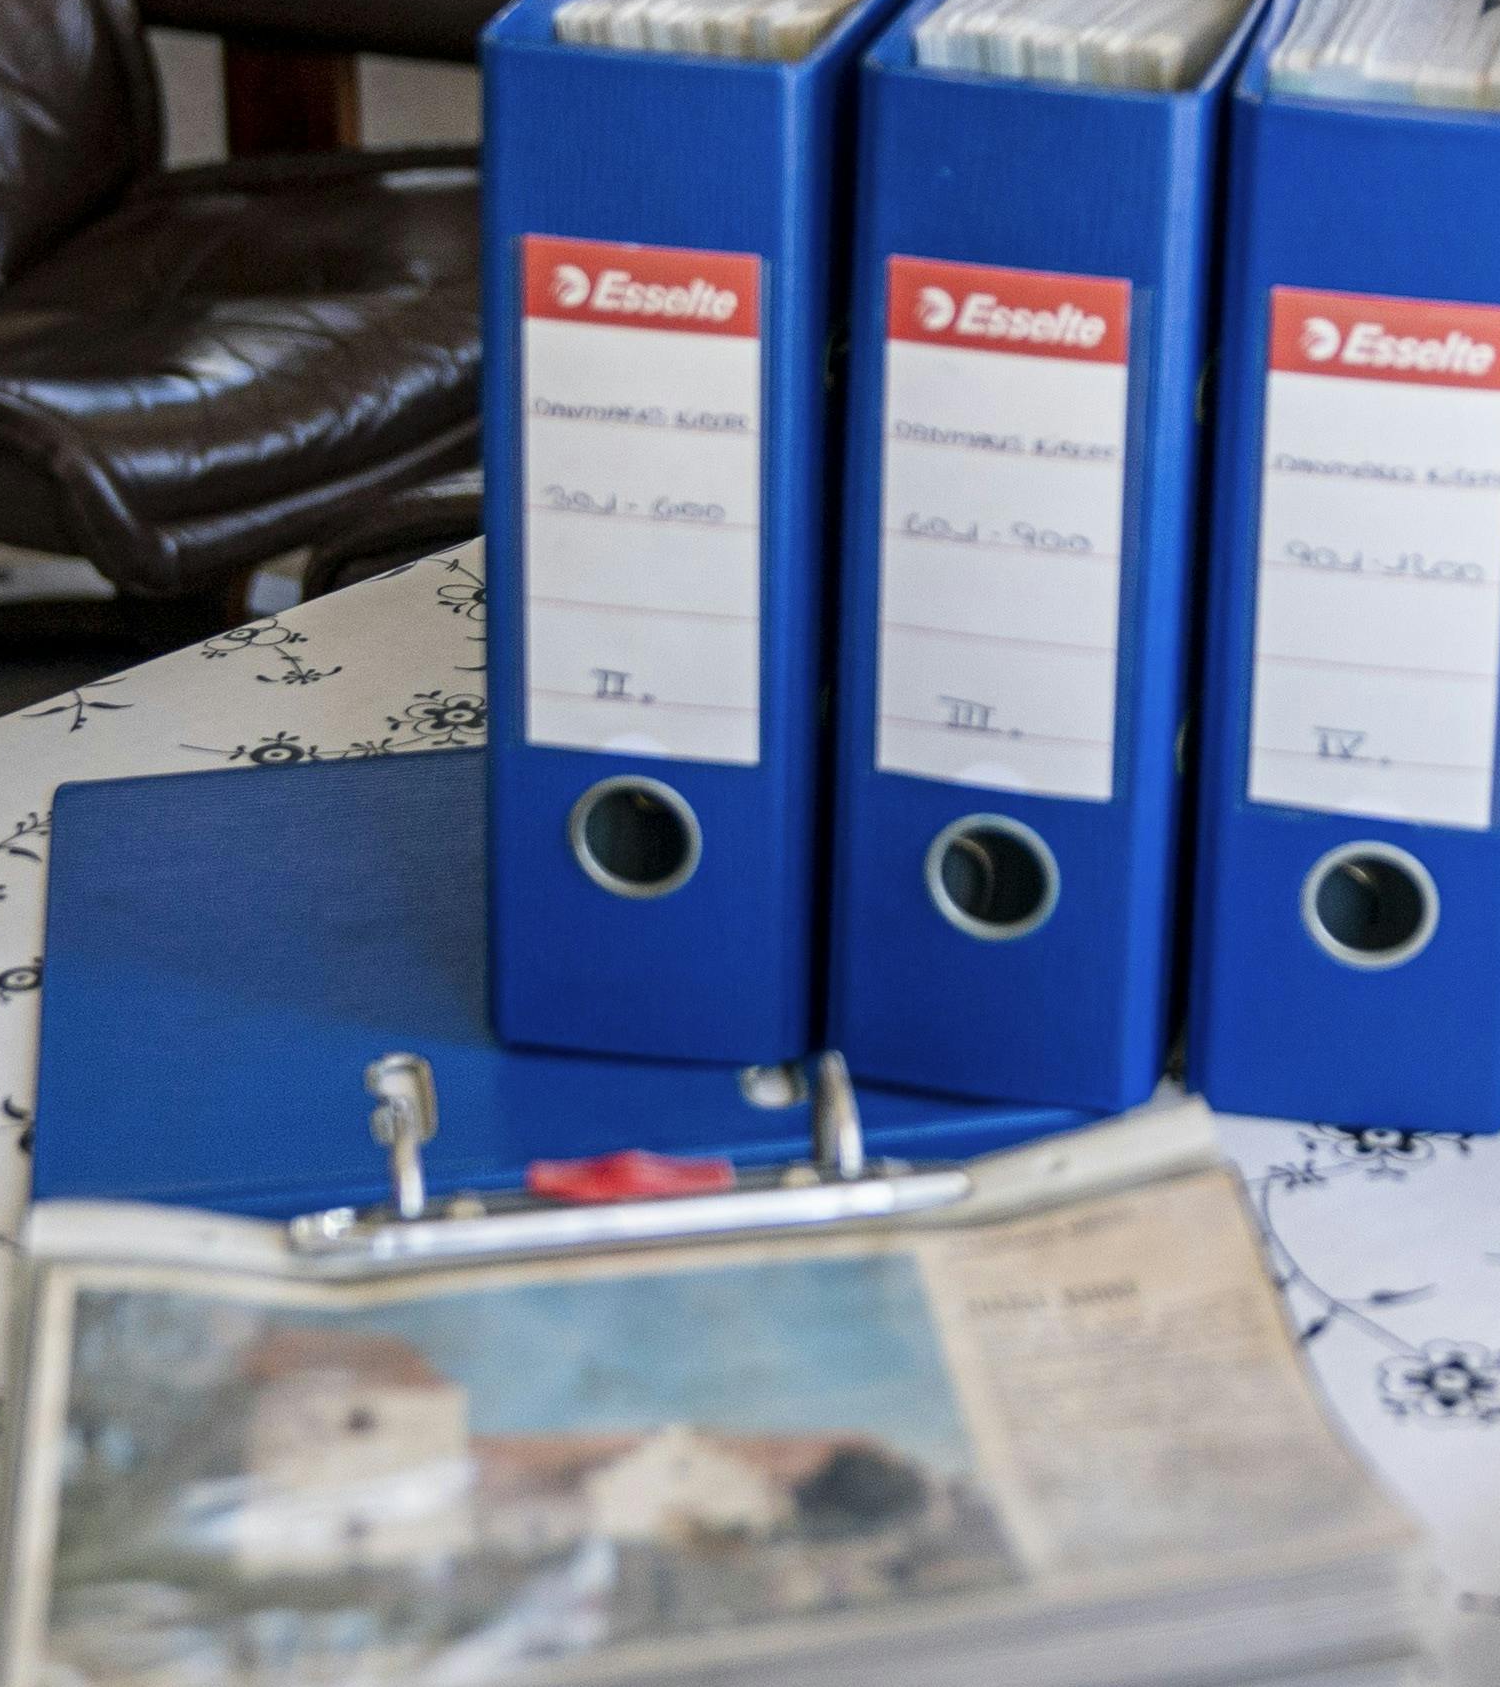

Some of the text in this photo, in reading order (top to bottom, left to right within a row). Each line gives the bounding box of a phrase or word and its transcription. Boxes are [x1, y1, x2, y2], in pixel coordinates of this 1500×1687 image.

[591, 269, 738, 322] Esselte
[955, 292, 1106, 349] Esselte
[1341, 324, 1496, 377] Esselte
[902, 510, 979, 543] 601
[1010, 519, 1094, 551] 900
